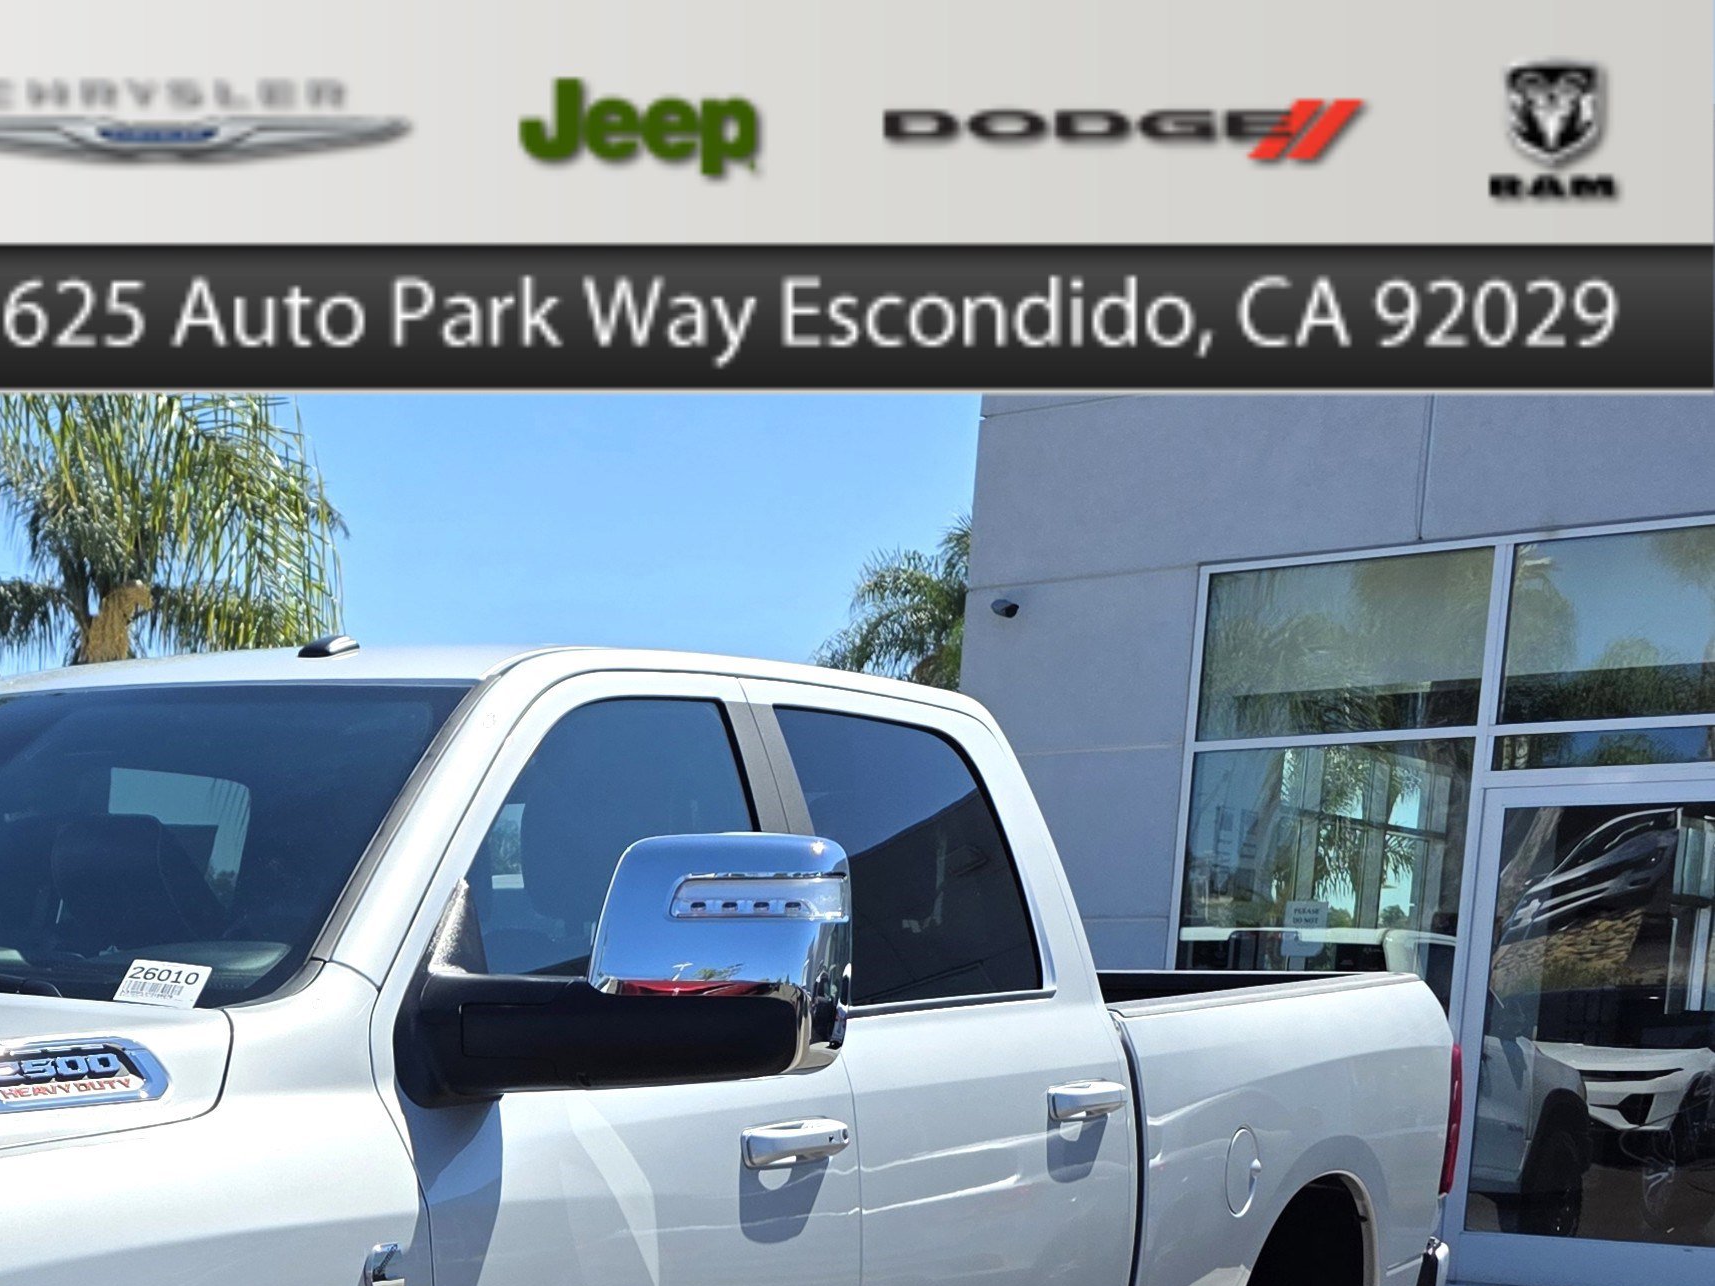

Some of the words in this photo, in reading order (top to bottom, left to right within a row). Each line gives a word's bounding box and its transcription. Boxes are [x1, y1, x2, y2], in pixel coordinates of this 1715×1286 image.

[128, 966, 200, 986] 26010
[0, 1083, 72, 1100] HEAVY
[74, 1078, 131, 1093] DUTY
